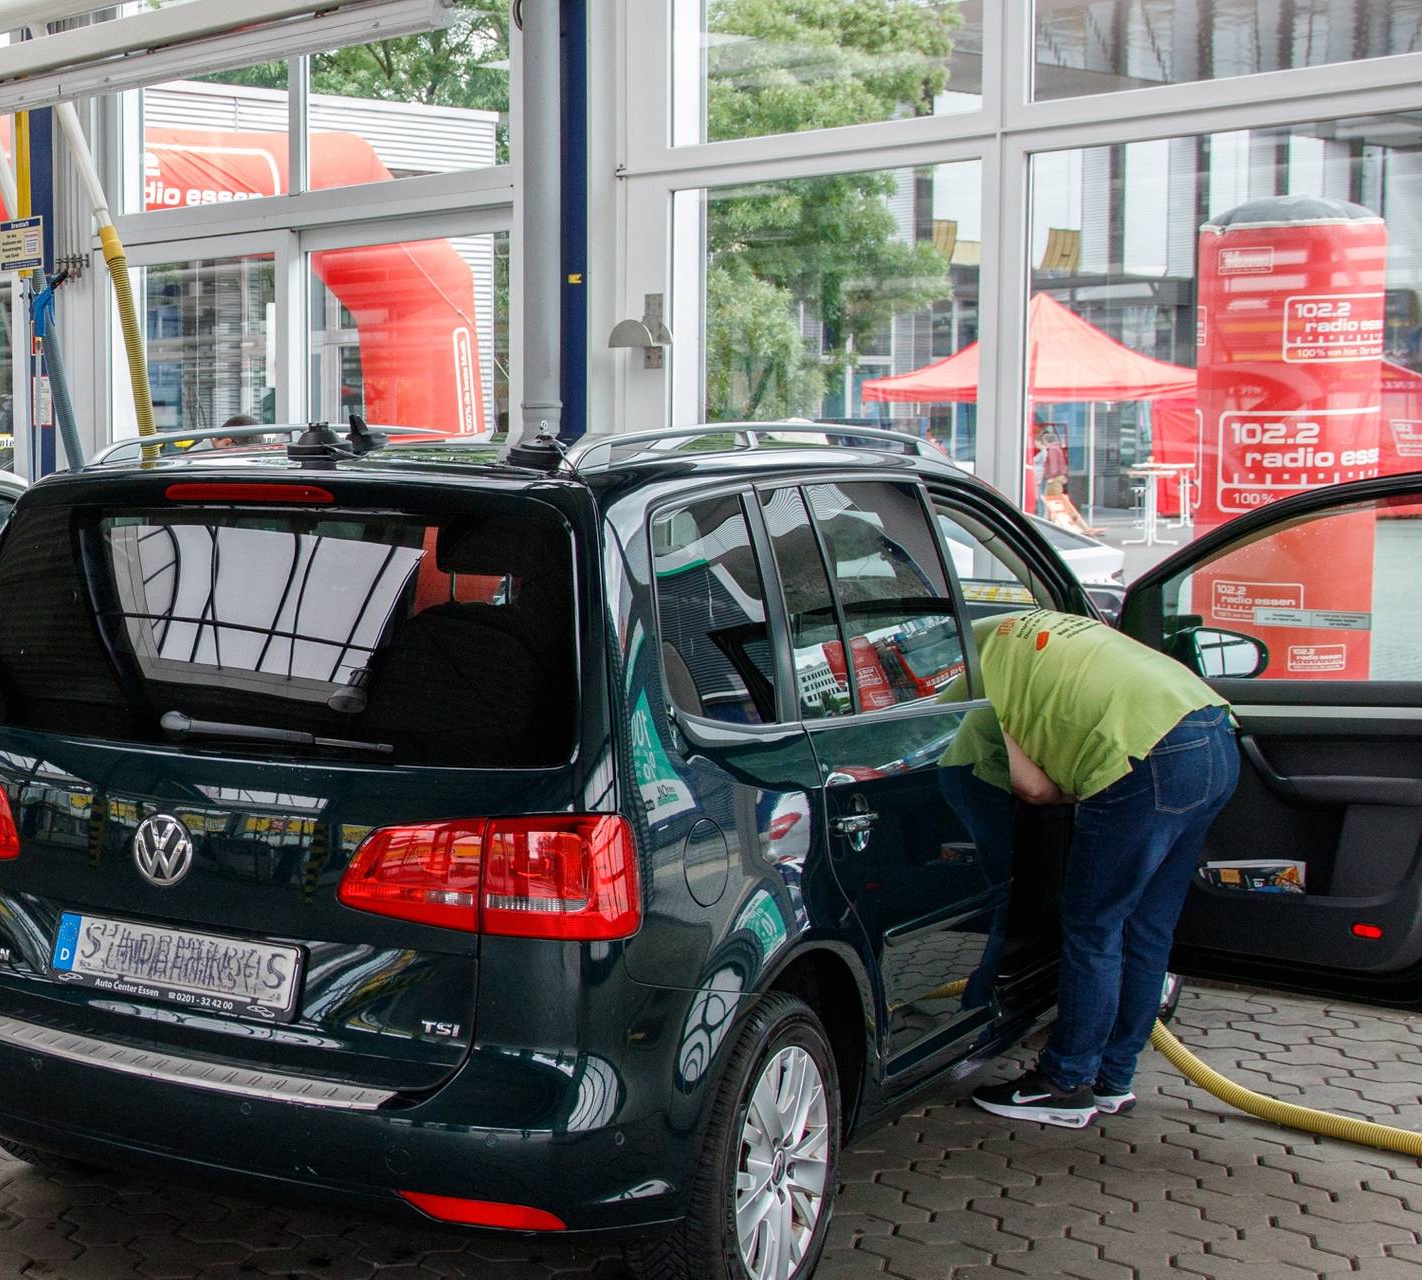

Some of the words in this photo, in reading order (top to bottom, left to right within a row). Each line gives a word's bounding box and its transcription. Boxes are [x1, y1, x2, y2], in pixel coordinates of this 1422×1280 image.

[146, 181, 181, 206] dio
[1294, 302, 1351, 318] 102.2
[1305, 319, 1359, 333] radio
[1231, 422, 1320, 445] 102.2
[1245, 447, 1335, 468] radio
[1216, 584, 1247, 596] 102.2
[1221, 595, 1253, 605] radio
[60, 947, 70, 961] D
[95, 978, 113, 989] Auto
[113, 980, 137, 993] Center
[138, 984, 159, 997] Essen
[177, 992, 195, 1004] 0201
[200, 996, 211, 1006] 32
[211, 998, 222, 1008] 42
[222, 999, 234, 1010] 00
[421, 1020, 460, 1037] TSI
